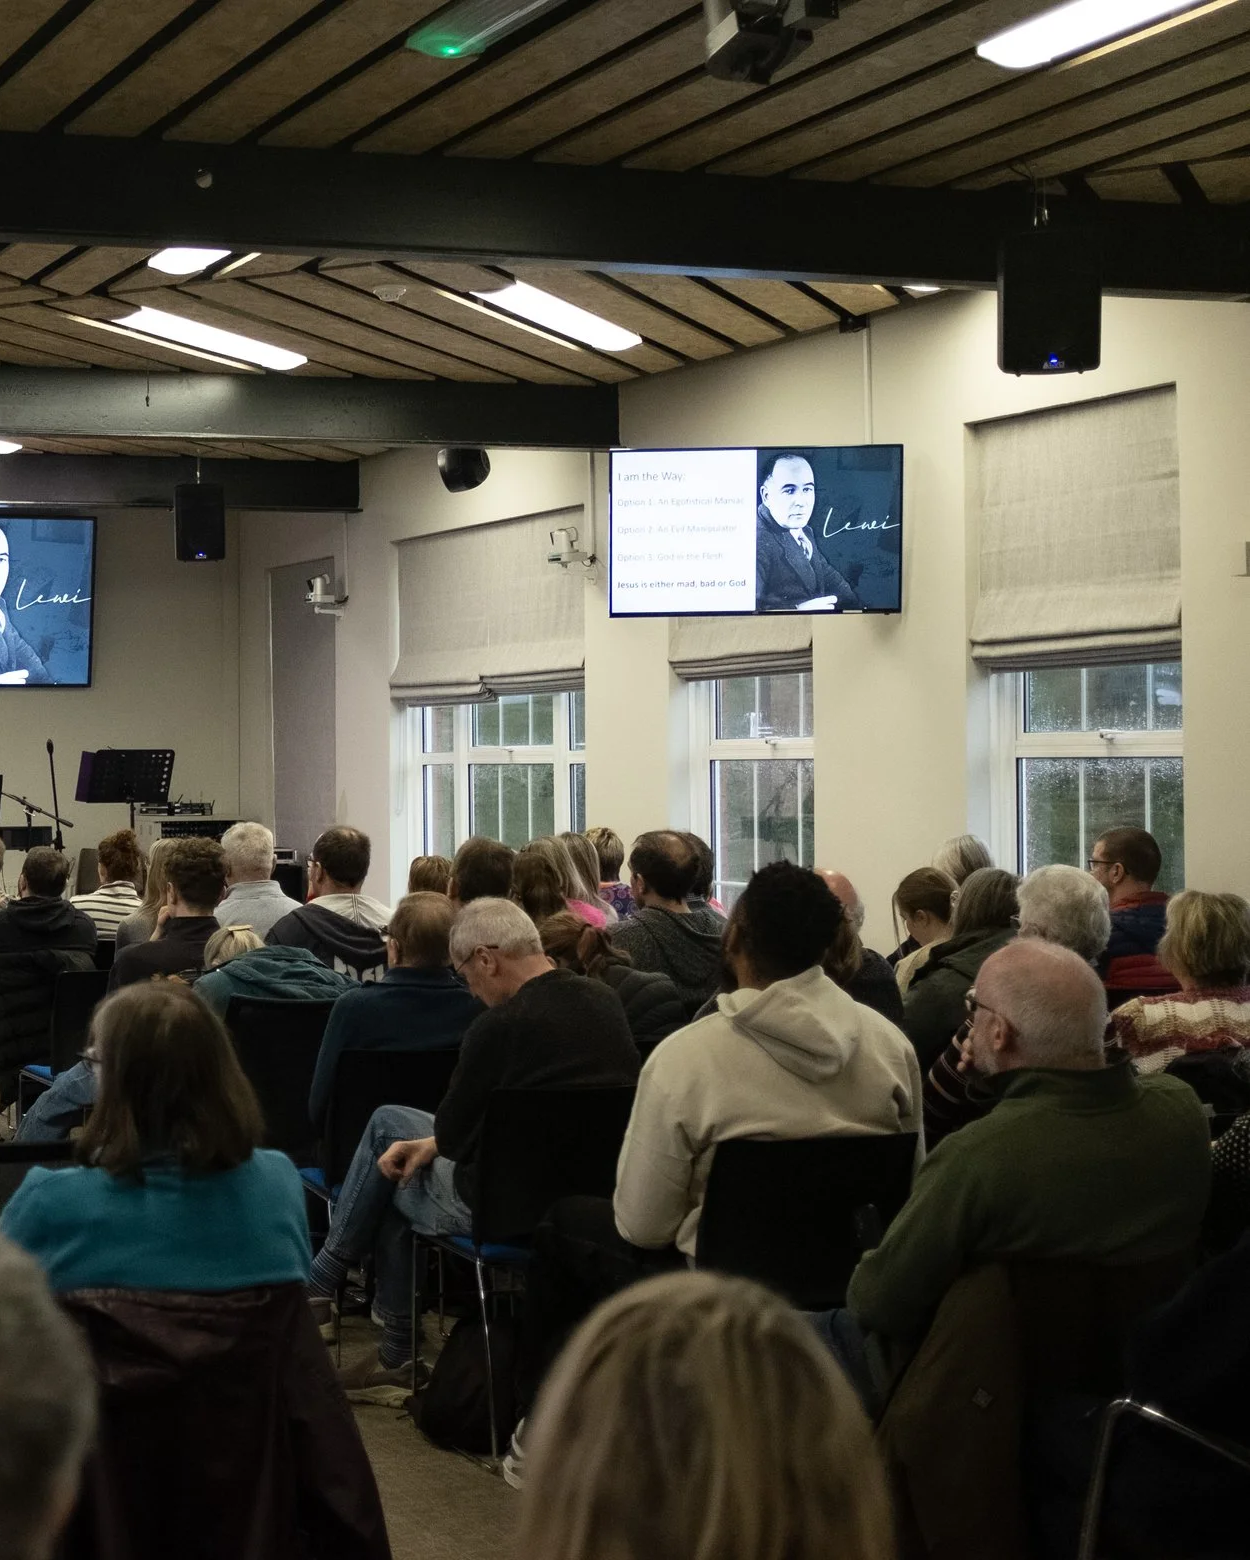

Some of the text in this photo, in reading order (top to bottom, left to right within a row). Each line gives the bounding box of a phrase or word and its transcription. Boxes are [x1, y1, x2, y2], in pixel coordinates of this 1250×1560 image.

[623, 474, 640, 482] am
[642, 472, 659, 481] the
[617, 498, 646, 508] Option
[657, 498, 669, 506] An
[822, 507, 900, 538] Lewi
[617, 526, 646, 535] Option
[617, 553, 646, 563] Option
[657, 553, 675, 562] God
[686, 553, 700, 561] the
[617, 581, 639, 589] Jesus
[641, 581, 648, 589] is
[650, 580, 675, 589] either
[677, 580, 698, 589] mad,
[700, 580, 716, 588] bad
[729, 579, 747, 587] God
[16, 579, 91, 610] Lewi
